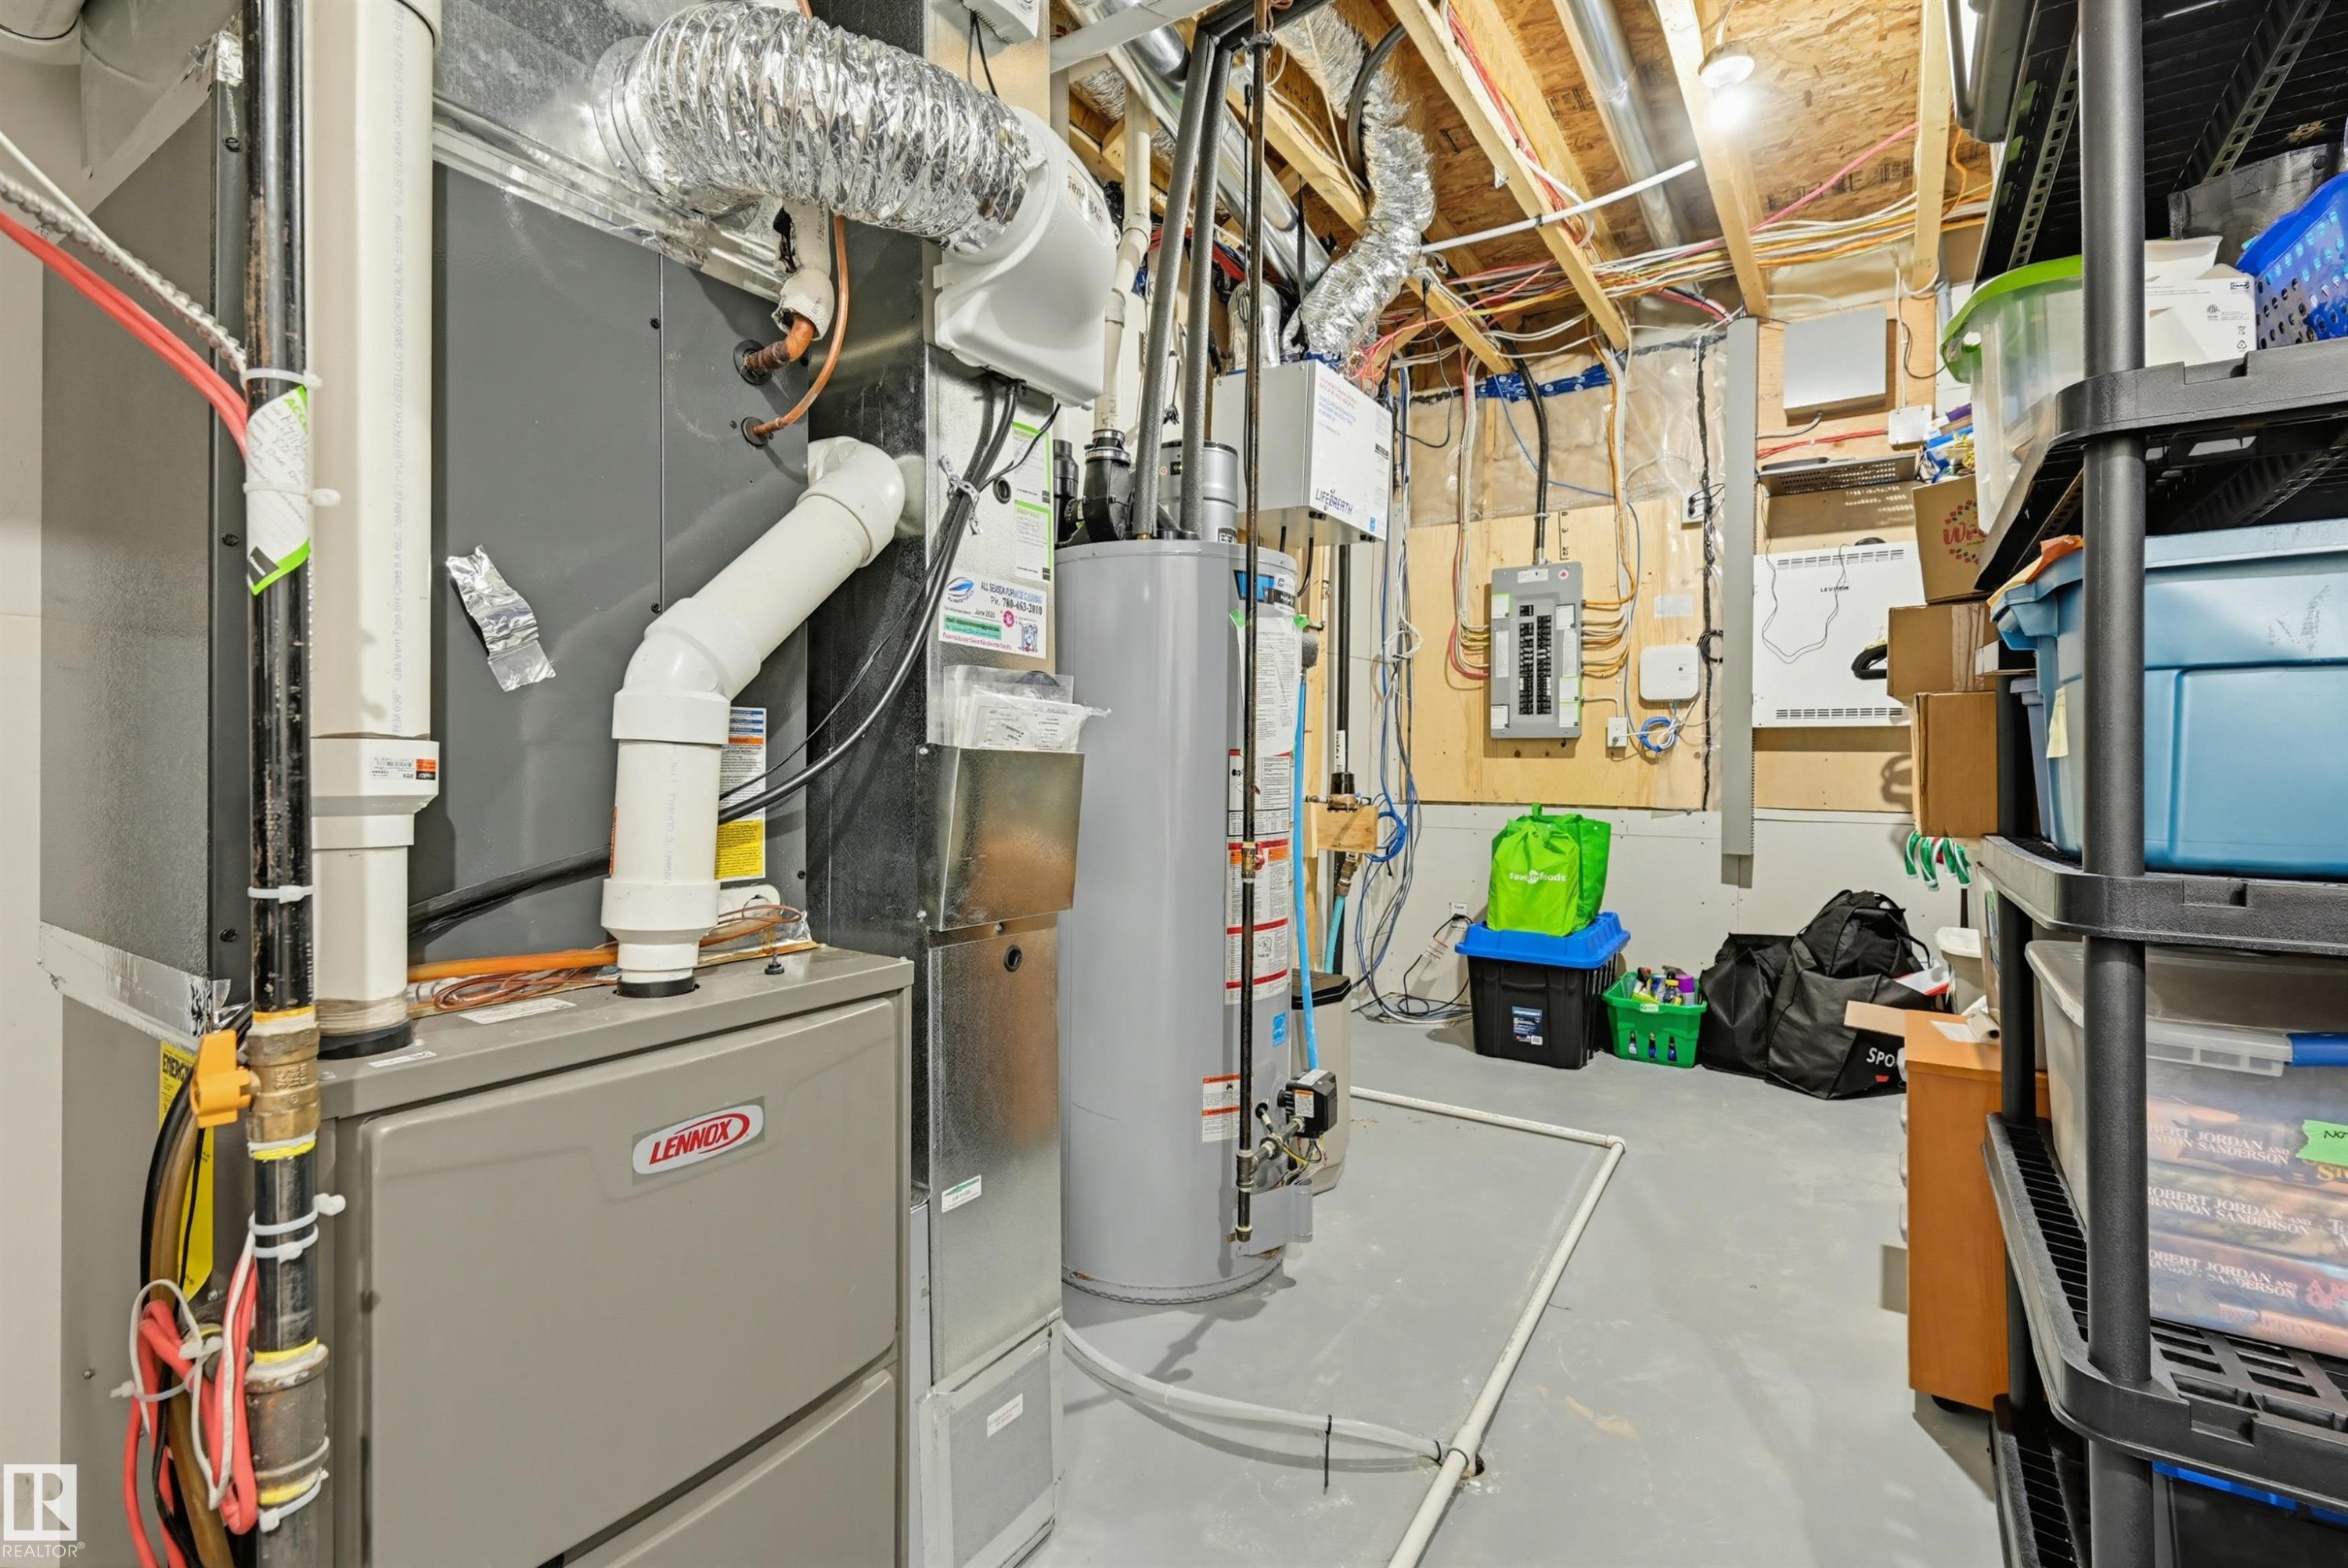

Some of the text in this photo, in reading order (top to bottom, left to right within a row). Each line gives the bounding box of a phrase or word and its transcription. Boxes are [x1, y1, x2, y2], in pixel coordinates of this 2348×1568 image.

[1866, 1047, 1897, 1067] SPO
[649, 1119, 733, 1166] LENNOX
[2148, 1124, 2290, 1156] BERT JORDAN AND
[2199, 1140, 2290, 1166] SANDERSON
[2213, 1198, 2284, 1219] JORDAN
[2289, 1217, 2312, 1226] AND
[2216, 1210, 2310, 1235] SANDERSON
[2205, 1261, 2272, 1283] JORDAN
